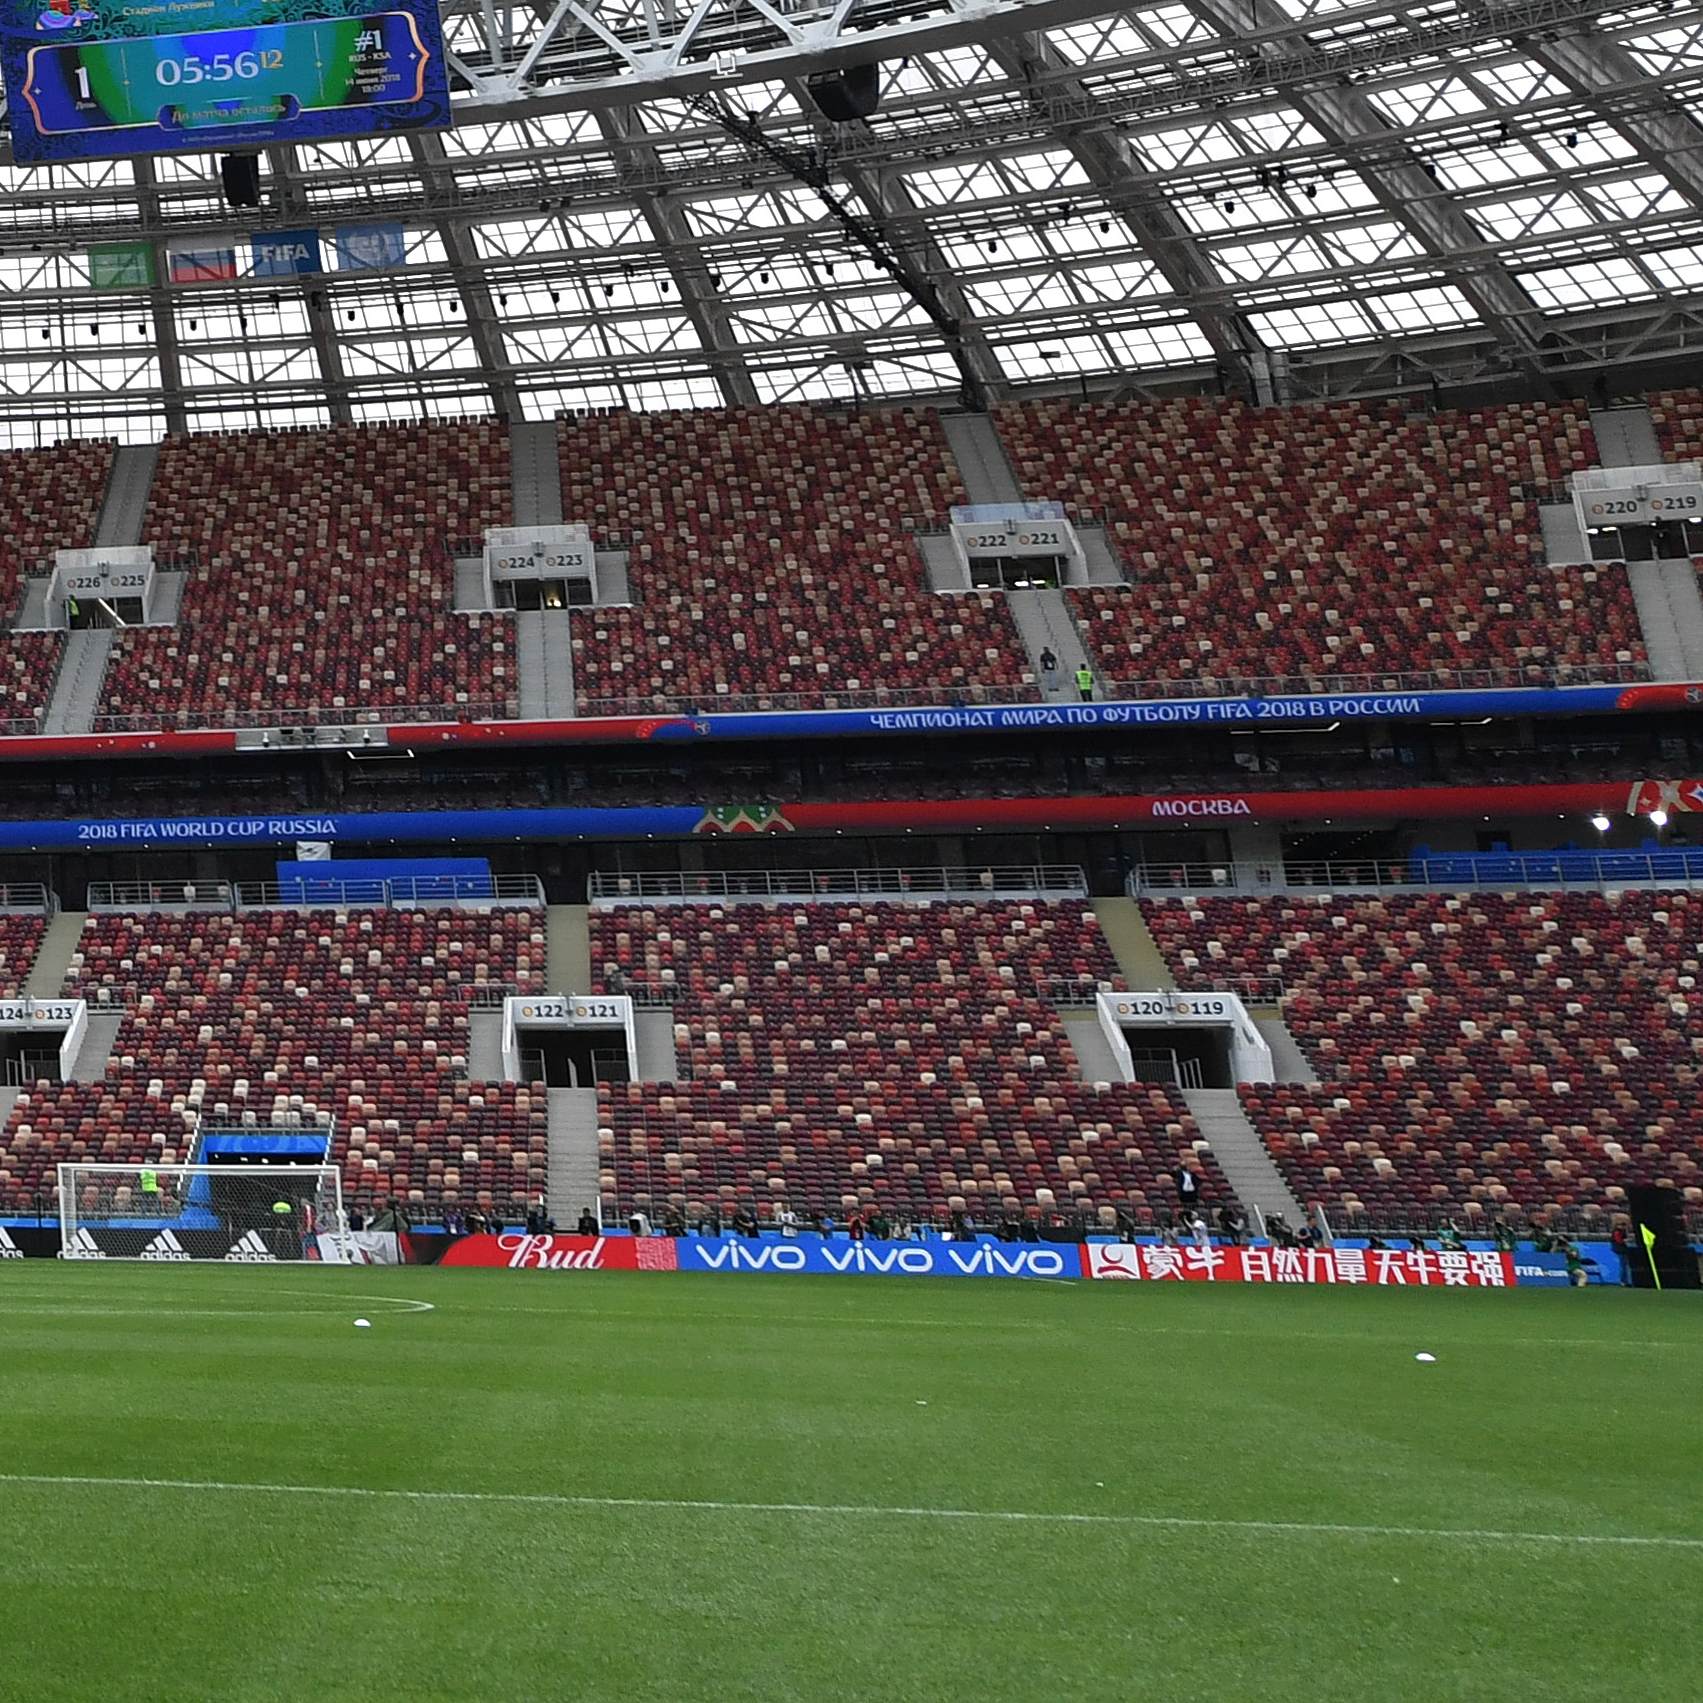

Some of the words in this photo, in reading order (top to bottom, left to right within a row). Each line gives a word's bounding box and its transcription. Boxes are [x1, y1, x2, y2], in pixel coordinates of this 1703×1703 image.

[353, 29, 382, 52] #1
[155, 51, 259, 86] 05:56
[259, 49, 284, 70] 12
[74, 66, 91, 99] 1
[261, 243, 310, 262] FIFA
[1604, 500, 1638, 515] 220
[1664, 496, 1697, 510] 219
[978, 535, 1007, 547] 222
[1030, 532, 1060, 545] 221
[509, 557, 535, 569] 224
[557, 554, 583, 567] 223
[76, 577, 101, 589] 226
[120, 575, 145, 587] 225
[870, 711, 996, 730] ЧЕМПИОНАТ
[1001, 708, 1064, 726] МИРА
[1066, 707, 1097, 724] ПО
[1102, 704, 1201, 722] ФУТБОЛУ
[1206, 702, 1253, 720] FIFA
[1257, 701, 1306, 717] 2018
[1310, 700, 1325, 716] В
[1328, 698, 1420, 715] РОССИИ
[1152, 799, 1251, 816] МОСКВА
[78, 824, 118, 839] 2018
[120, 822, 157, 838] FIFA
[160, 821, 225, 838] WORLD
[227, 820, 265, 836] CUP
[268, 818, 338, 835] RUSSIA
[46, 1007, 73, 1020] 123
[535, 1004, 564, 1017] 122
[589, 1004, 618, 1017] 121
[1130, 1001, 1163, 1015] 120
[1191, 1001, 1224, 1015] 119
[140, 1249, 192, 1261] adidas
[225, 1250, 276, 1262] adidas
[498, 1234, 606, 1270] Bud
[1142, 1244, 1225, 1281] 蒙牛
[1240, 1246, 1368, 1285] 自然力量
